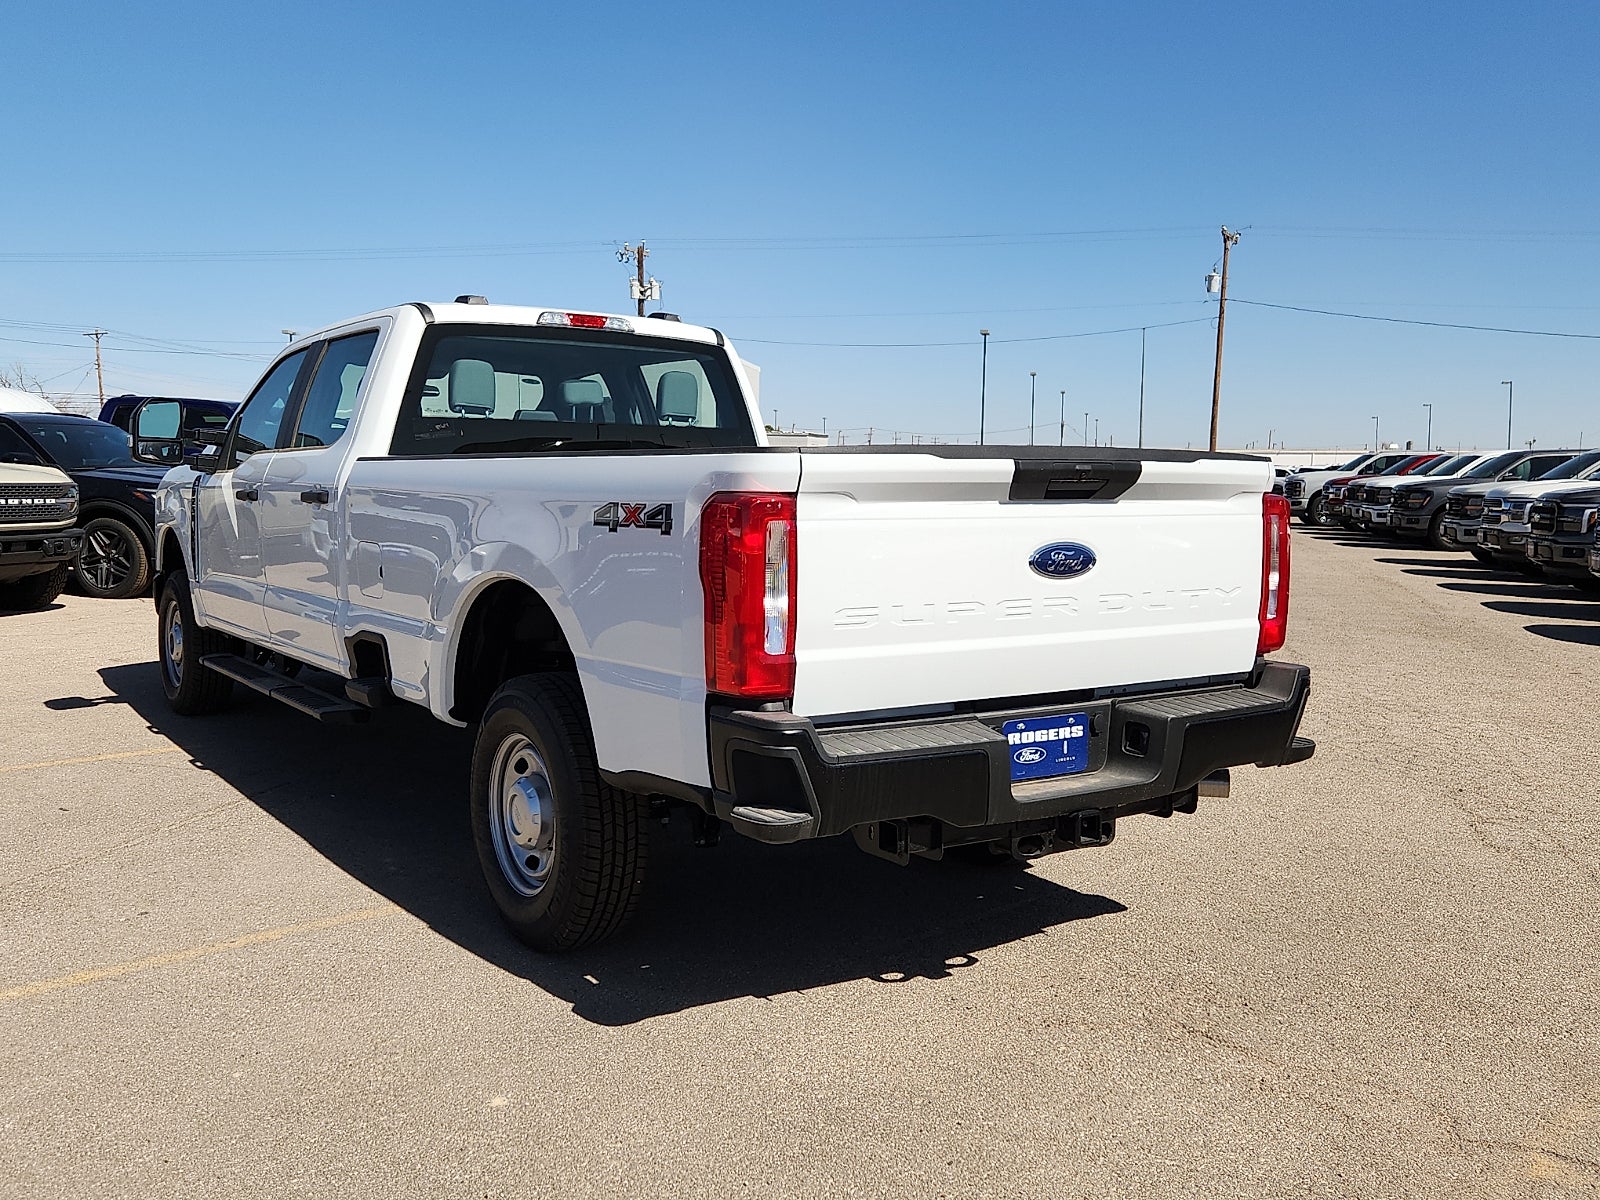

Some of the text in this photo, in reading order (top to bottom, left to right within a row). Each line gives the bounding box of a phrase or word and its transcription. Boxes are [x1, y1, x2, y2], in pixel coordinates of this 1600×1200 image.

[1046, 549, 1084, 571] Ford
[833, 586, 1241, 630] SUPER DUTY
[1007, 725, 1084, 746] ROGERS
[1019, 748, 1042, 762] Ford
